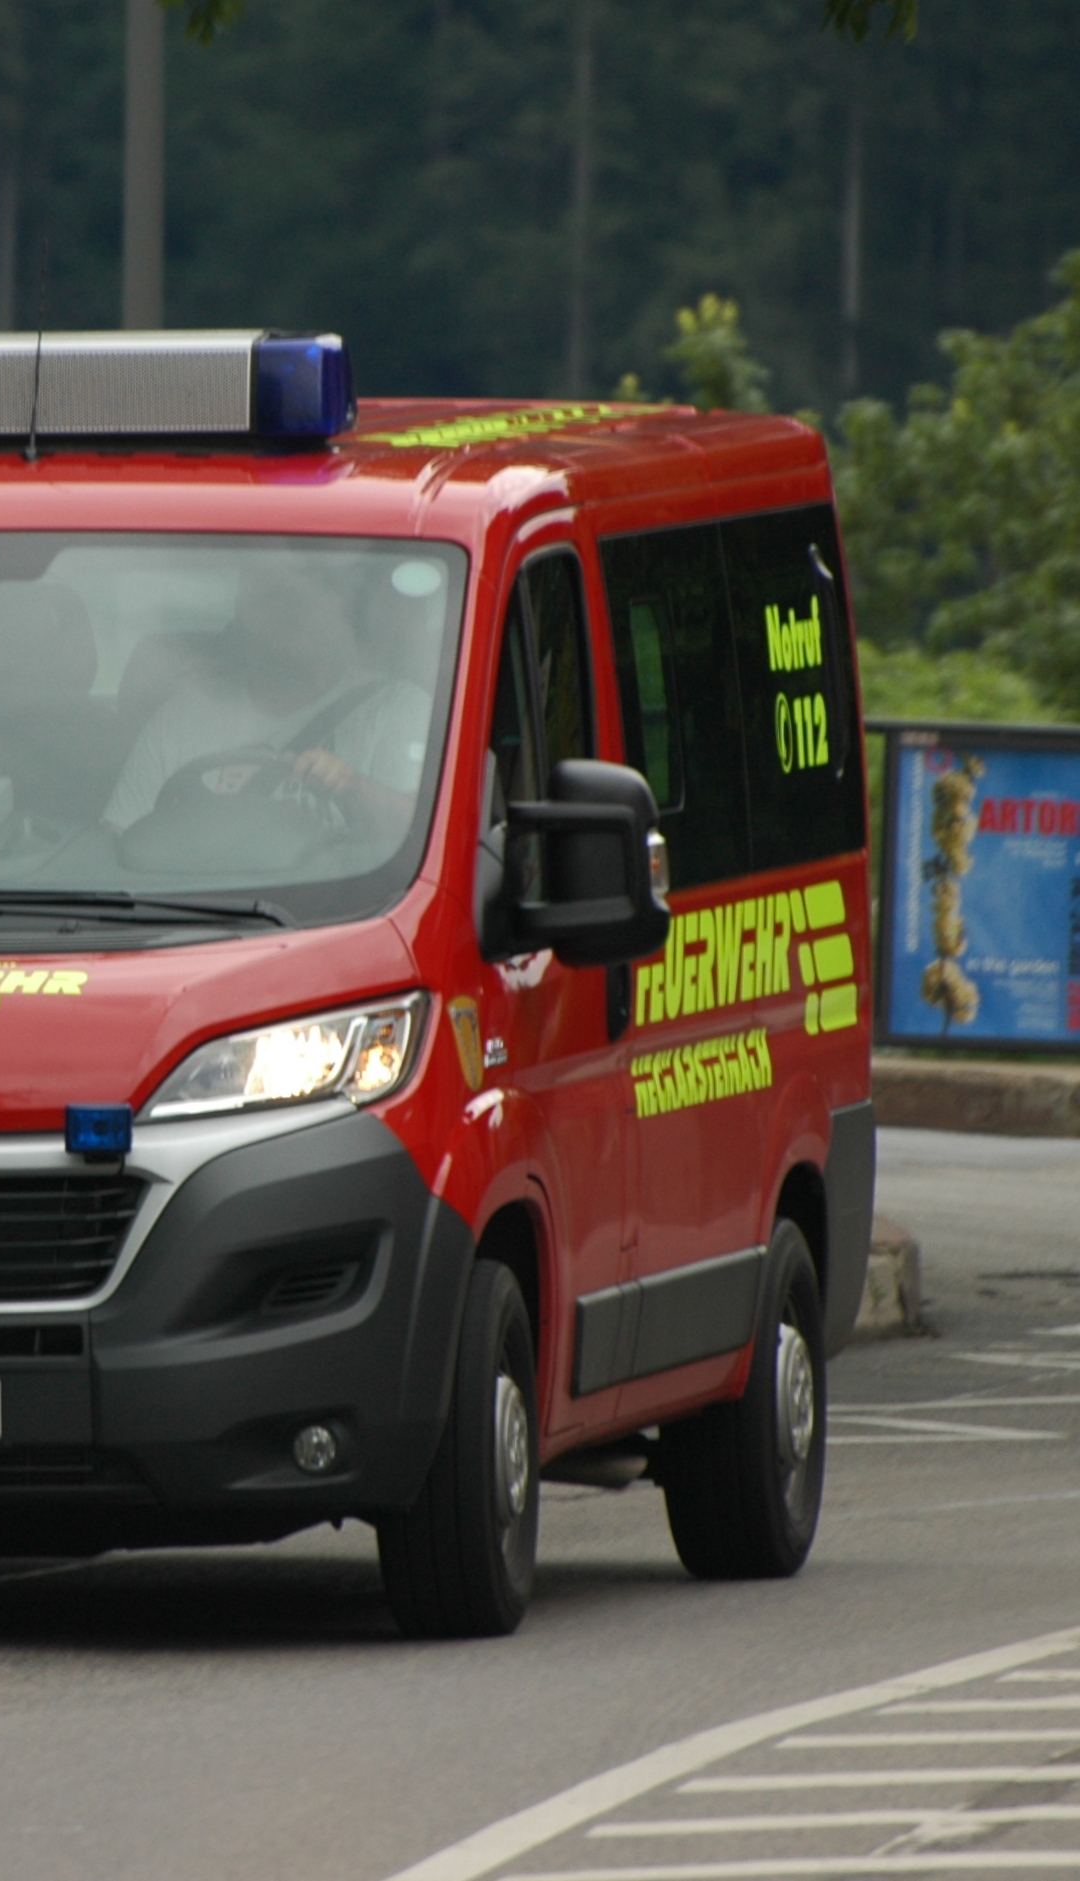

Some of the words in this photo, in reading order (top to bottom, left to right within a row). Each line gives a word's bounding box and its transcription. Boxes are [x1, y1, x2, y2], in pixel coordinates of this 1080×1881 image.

[766, 594, 822, 671] Notruf
[793, 692, 829, 769] 112
[978, 798, 1080, 835] ARTOR
[635, 891, 791, 1027] FEUERWEHR
